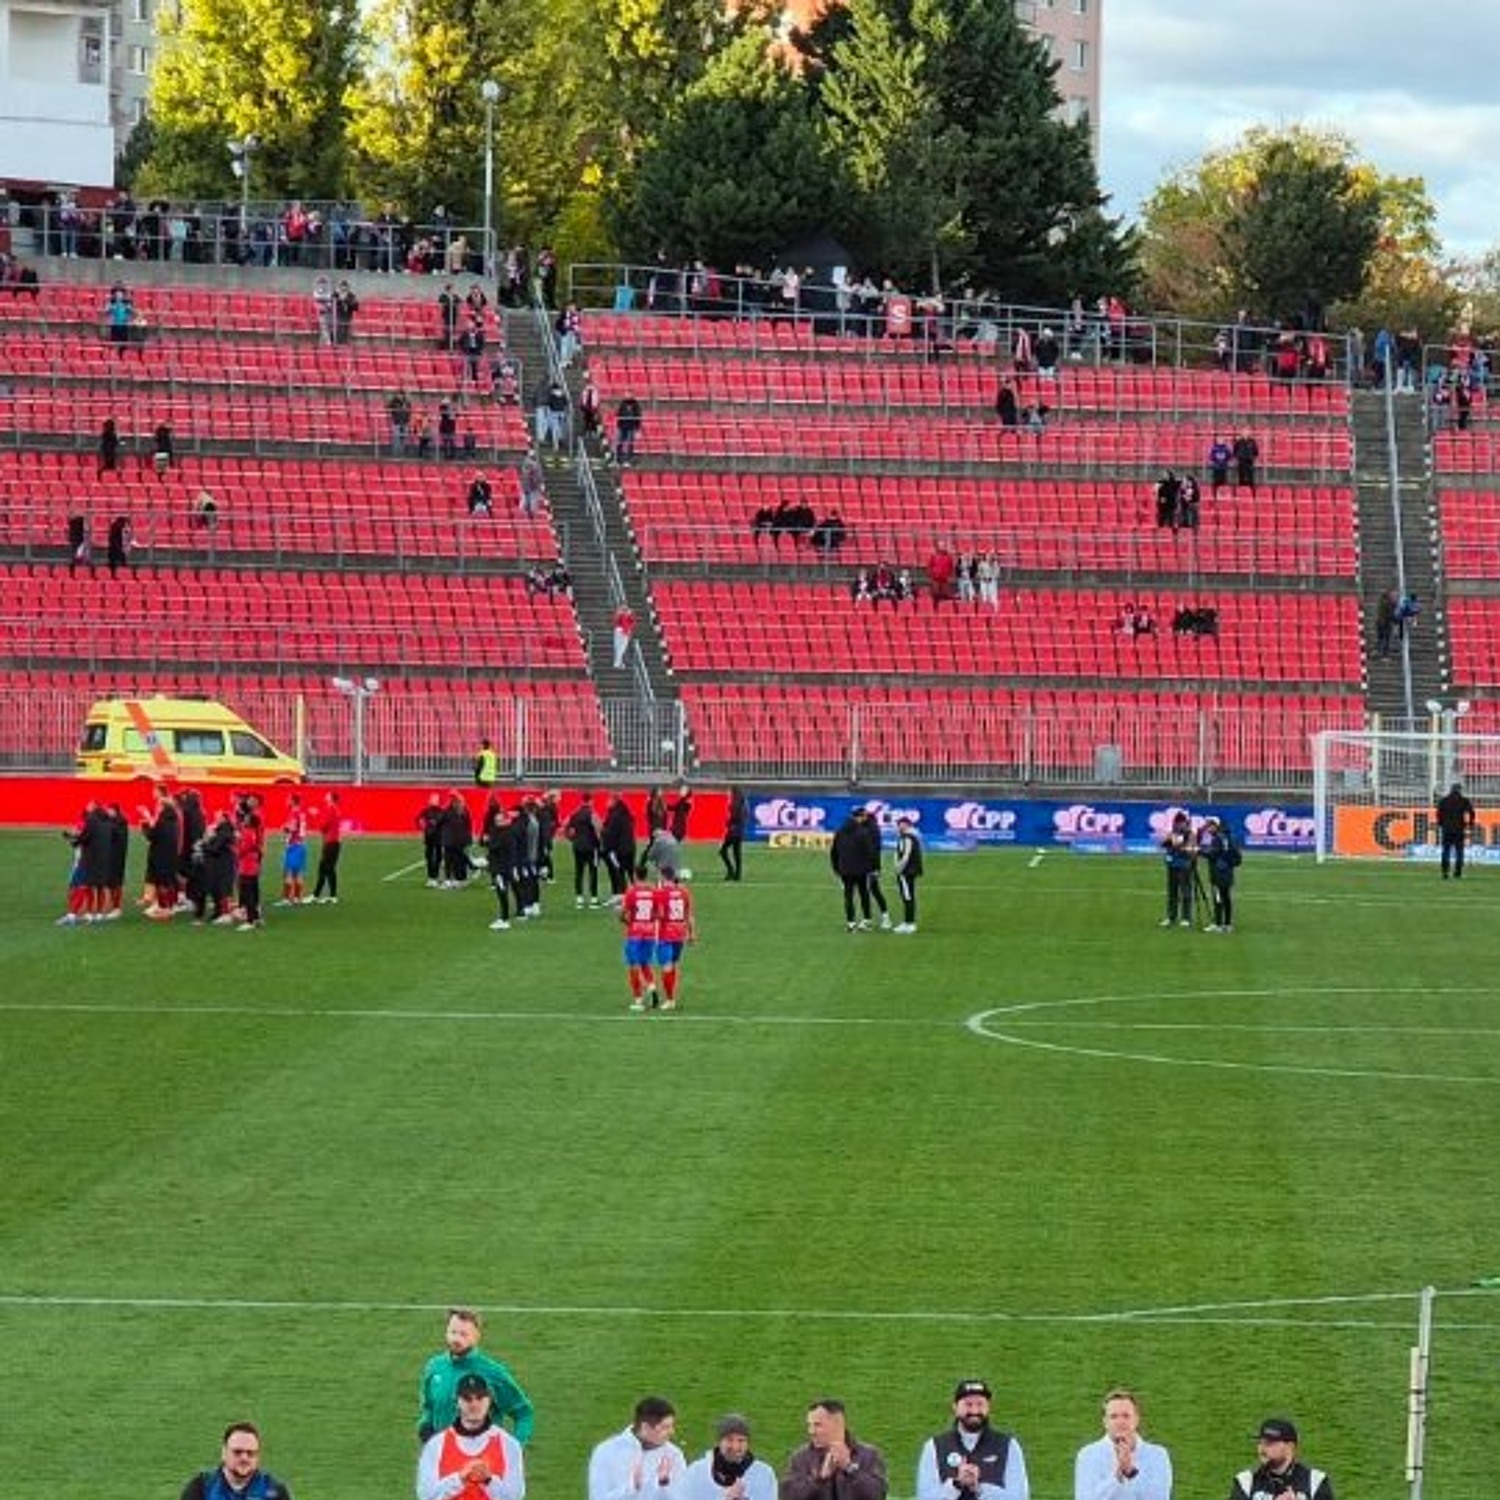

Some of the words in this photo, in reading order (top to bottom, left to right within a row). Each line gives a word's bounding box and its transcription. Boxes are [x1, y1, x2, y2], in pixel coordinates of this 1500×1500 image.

[780, 804, 826, 827] ČPP
[971, 806, 1017, 830] ČPP
[1079, 809, 1125, 832] ČPP
